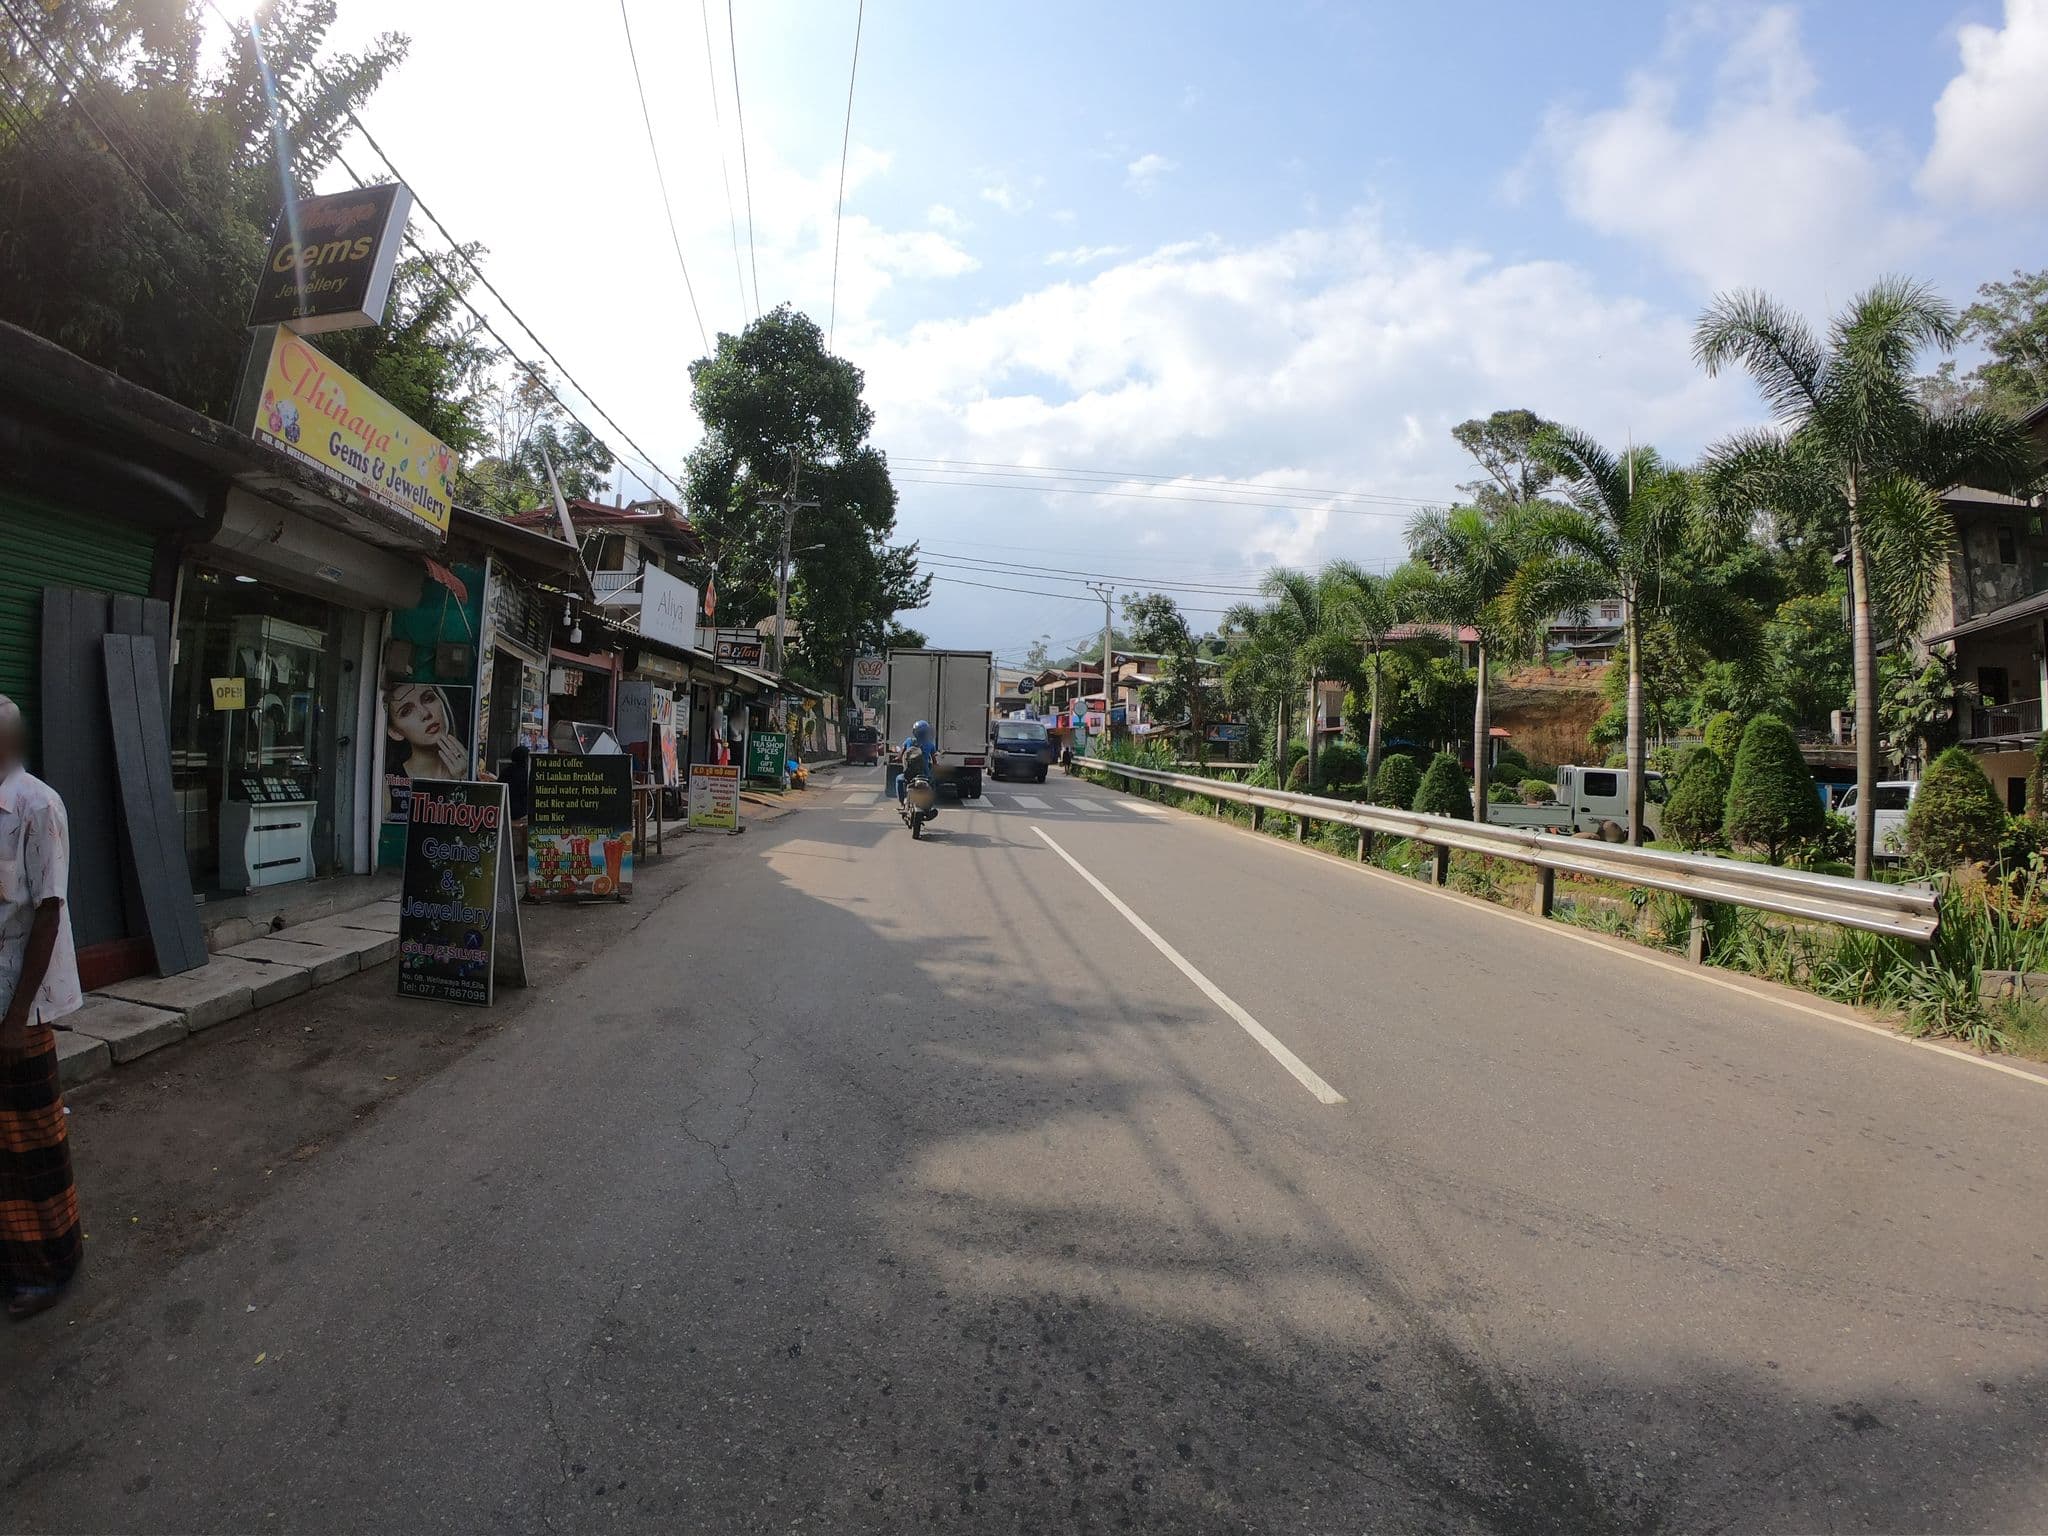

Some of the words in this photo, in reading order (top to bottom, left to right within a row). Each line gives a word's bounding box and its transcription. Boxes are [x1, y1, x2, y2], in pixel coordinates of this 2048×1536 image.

[272, 236, 373, 273] Gems
[275, 277, 348, 299] Jewellery
[280, 342, 392, 453] Thinaya
[329, 431, 370, 475] Gems
[372, 457, 385, 480] &
[386, 466, 446, 522] Jewellery
[216, 686, 243, 698] OPEN
[752, 740, 765, 748] TEA
[766, 742, 784, 750] SHOP
[536, 758, 547, 768] Tea
[549, 758, 561, 768] and
[562, 758, 584, 768] Coffee
[536, 771, 545, 781] Sri
[547, 771, 571, 781] Lankan
[573, 772, 604, 781] Breakfast
[536, 785, 558, 795] Minral
[582, 785, 600, 795] Fresh
[600, 785, 618, 795] Juice
[410, 791, 500, 833] Thinaya
[536, 799, 549, 808] Best
[551, 799, 565, 808] Rice
[566, 799, 578, 808] and
[580, 799, 600, 811] Curry
[551, 812, 566, 822] Rice
[421, 837, 480, 863] Gems
[441, 869, 455, 889] &
[400, 895, 493, 930] Jewellery
[401, 943, 435, 957] GOLD
[447, 947, 488, 961] SILVER
[402, 981, 417, 993] Tel:
[419, 983, 436, 994] 077
[443, 987, 487, 1002] 7867098
